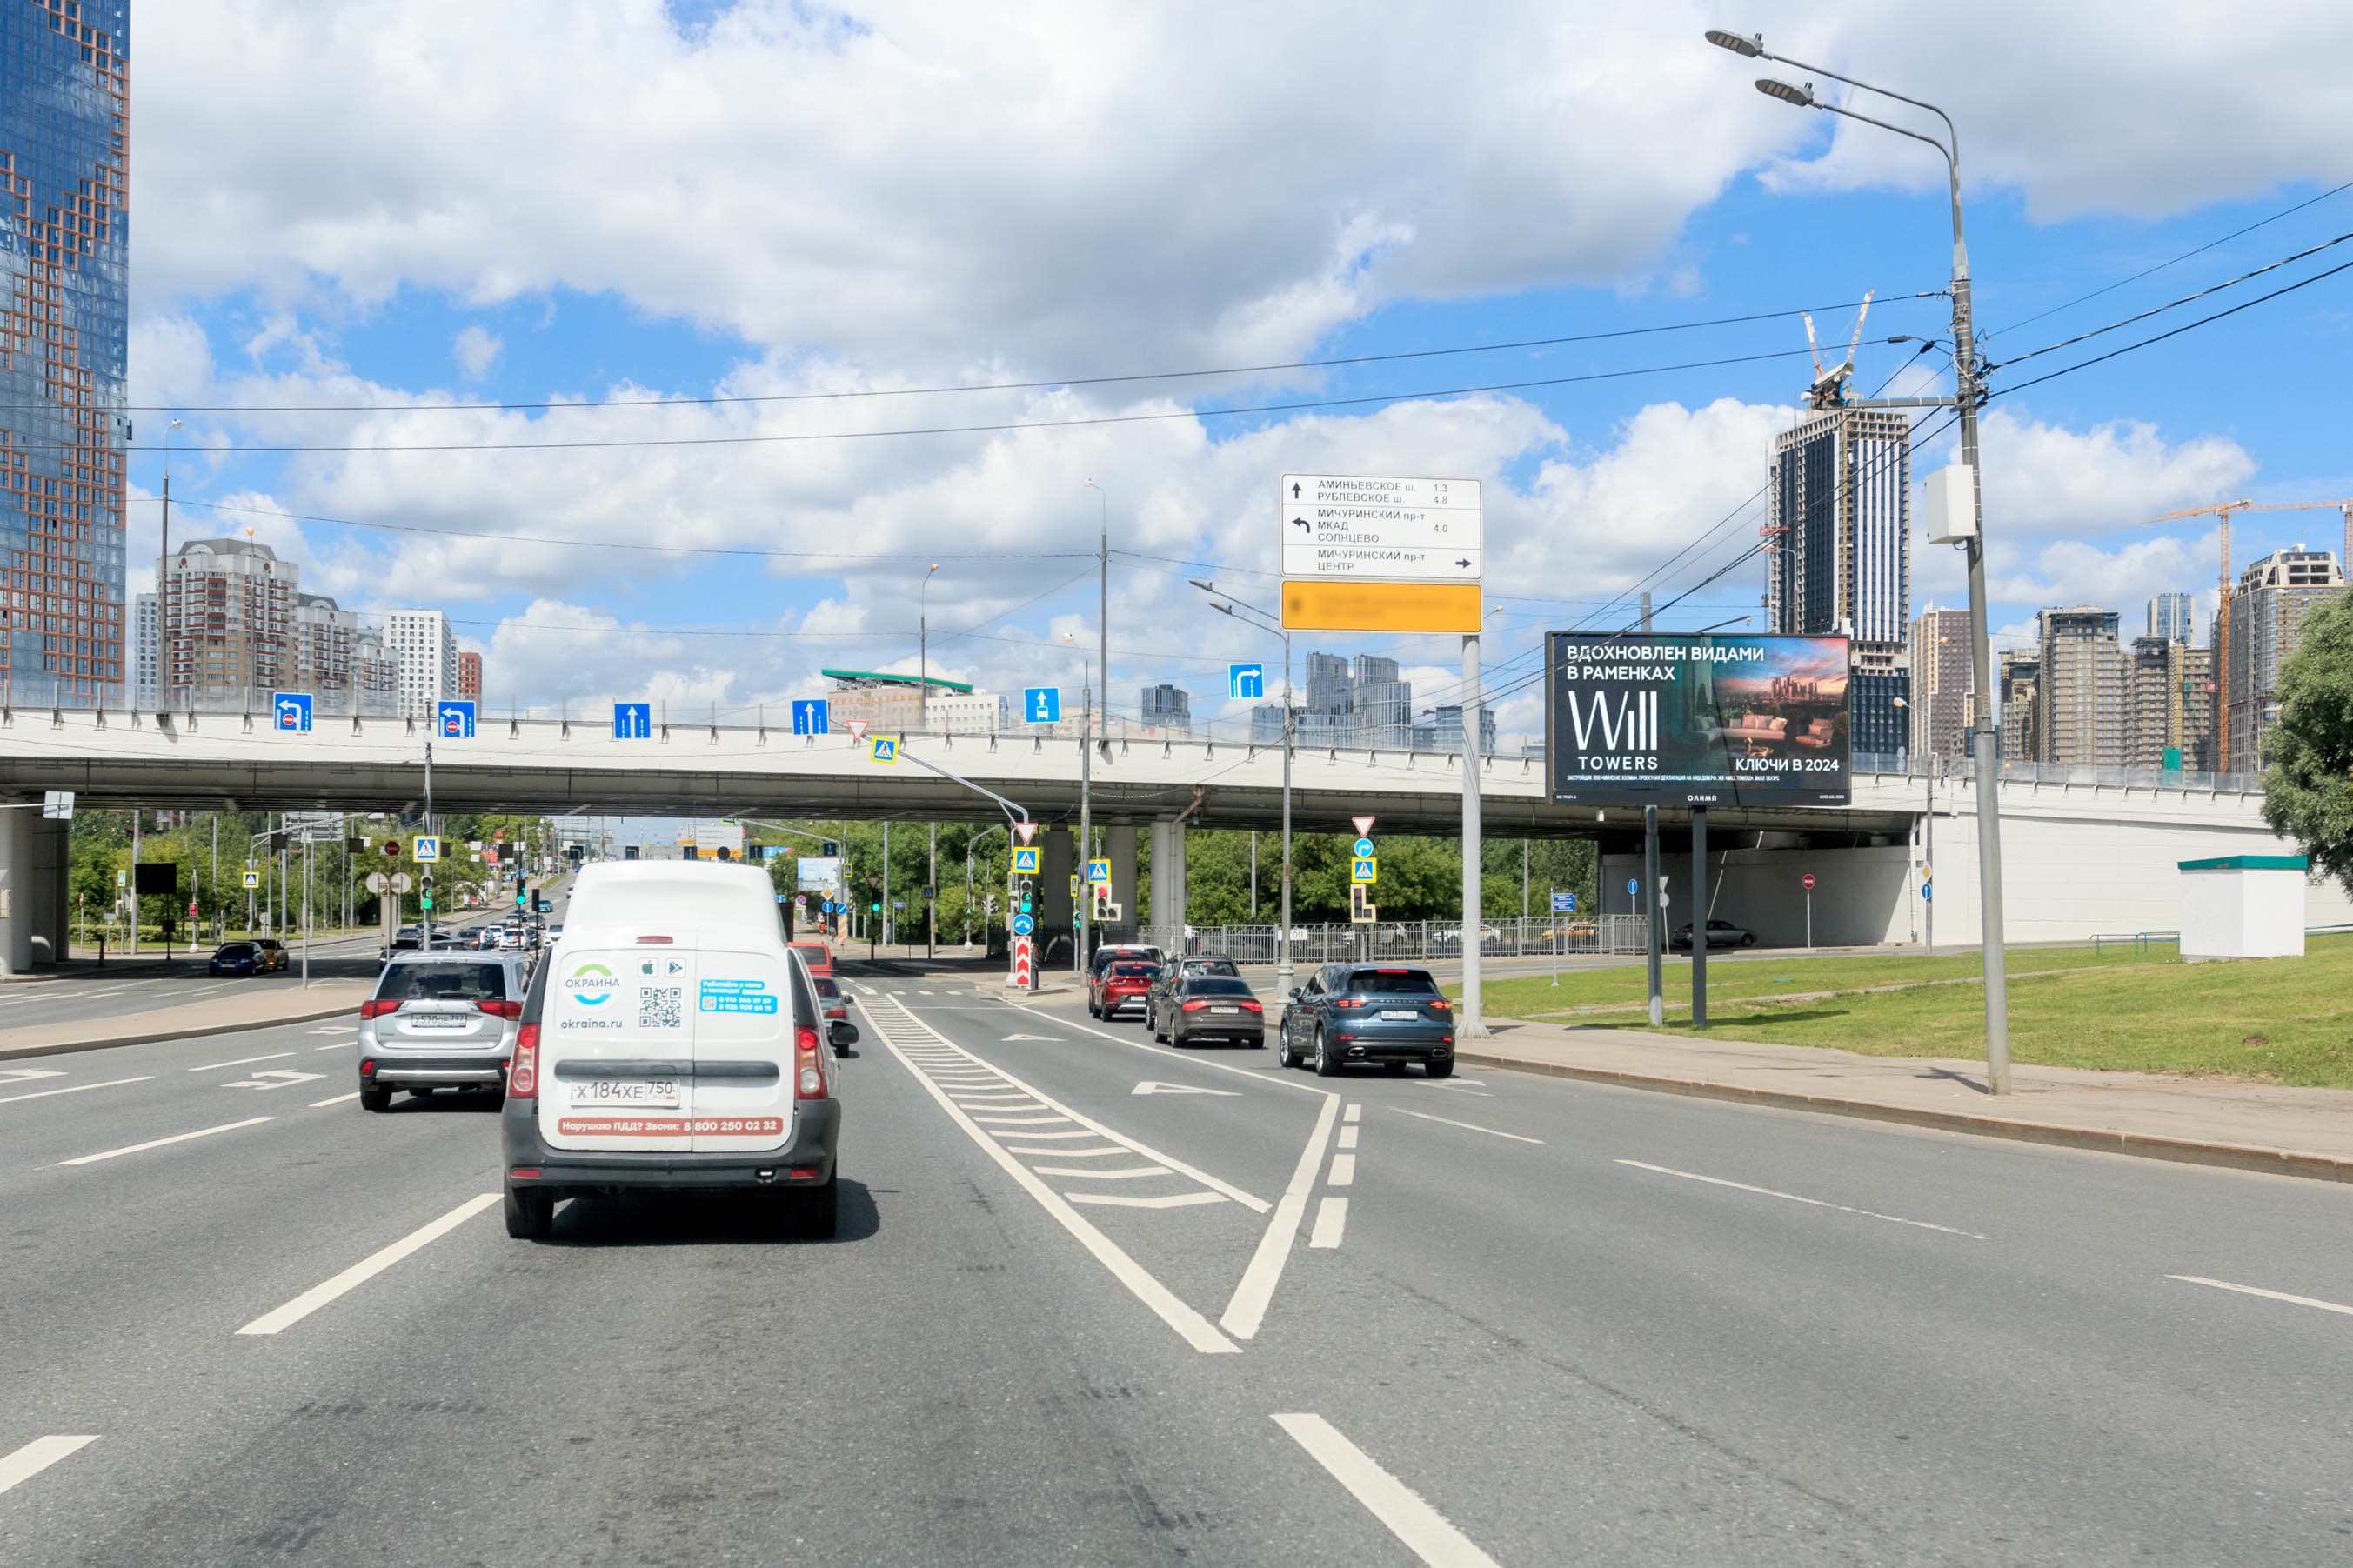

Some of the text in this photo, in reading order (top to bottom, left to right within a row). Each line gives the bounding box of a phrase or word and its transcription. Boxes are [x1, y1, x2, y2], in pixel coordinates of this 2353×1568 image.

[1318, 480, 1401, 491] АМИНЬЕВСКОЕ
[1434, 484, 1447, 493] 1.3
[1318, 492, 1390, 504] РУБЛЕВСКОЕ
[1433, 496, 1447, 505] 4.8
[1318, 509, 1426, 521] МИЧУРИНСКИЙ пр-т
[1318, 521, 1448, 533] МКАД 4.0
[1318, 532, 1380, 544] СОЛНЦЕВО
[1318, 550, 1426, 563] МИЧУРИНСКИЙ пр-т
[1318, 562, 1354, 571] ЦЕНТР
[1567, 645, 1764, 663] ВДОХНОВЛЕН ВИДАМИ
[1567, 666, 1675, 681] В РАМЕНКАХ
[1578, 756, 1659, 771] TOWERS
[1735, 758, 1840, 772] КЛЮЧИ В 2024
[1687, 794, 1717, 803] ОЛИМП
[565, 978, 619, 988] ОКРАИНА
[560, 1018, 623, 1030] okraina.ru
[577, 1081, 673, 1098] Х184ХЕ 750
[562, 1122, 612, 1132] Нарушаю
[614, 1122, 643, 1131] ПДД?
[683, 1122, 691, 1131] 8
[694, 1121, 718, 1131] 800
[720, 1121, 741, 1131] 250
[745, 1120, 760, 1131] 02
[763, 1120, 778, 1130] 32
